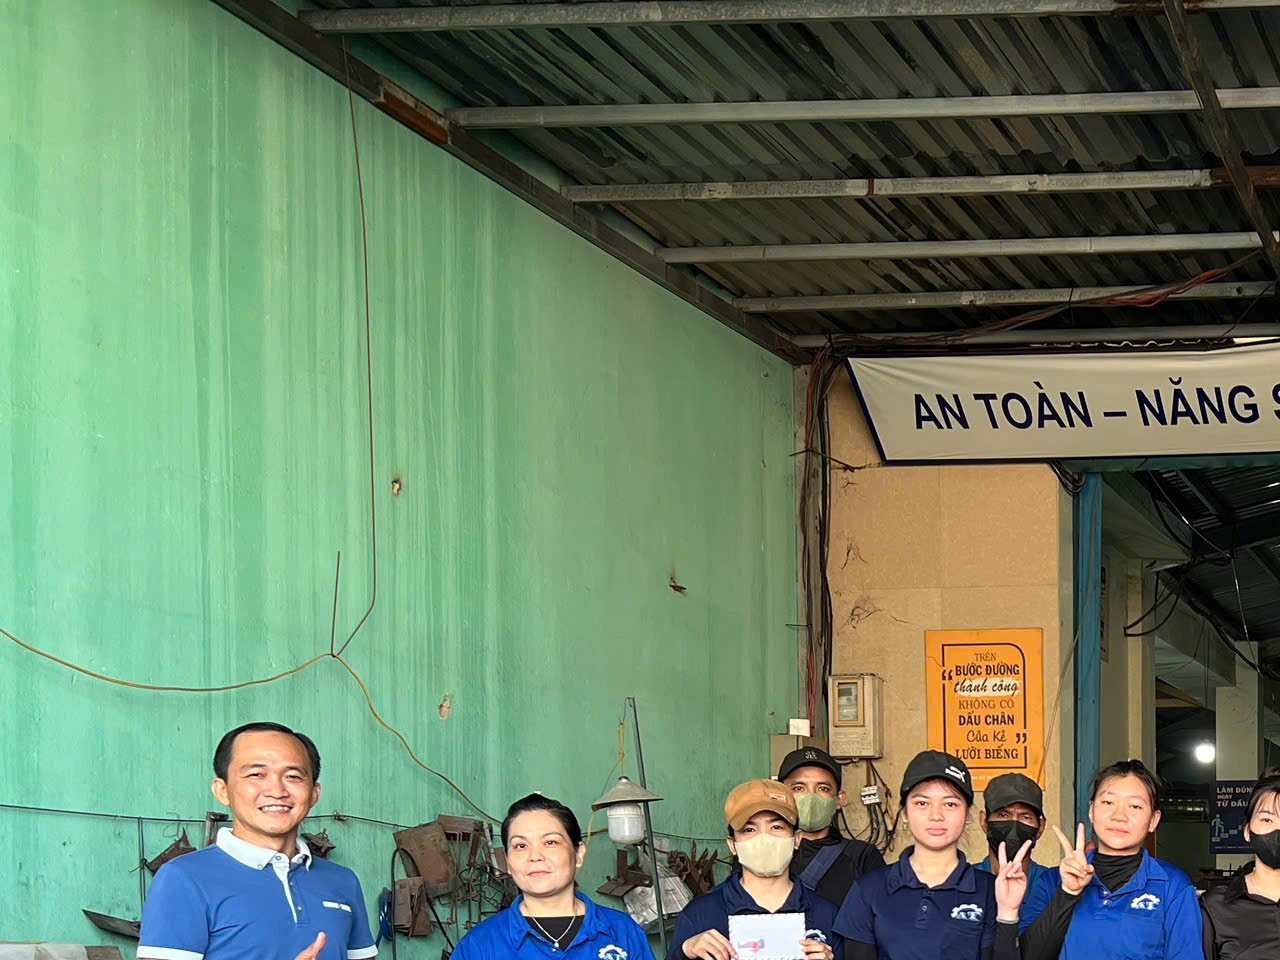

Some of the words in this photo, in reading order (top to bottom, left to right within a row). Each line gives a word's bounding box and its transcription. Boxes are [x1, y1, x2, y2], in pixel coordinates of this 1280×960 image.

[914, 393, 970, 430] AN
[973, 381, 1093, 430] TOÀN
[1135, 376, 1260, 426] NĂNG
[974, 652, 997, 662] TRÊN
[955, 664, 982, 676] BƯỚC
[985, 663, 1020, 676] ĐƯỜNG
[954, 678, 988, 693] thành
[991, 680, 1019, 696] công
[958, 697, 996, 709] KHÔNG
[999, 697, 1015, 709] CÓ
[958, 710, 981, 726] DẤU
[984, 712, 1015, 726] CHÂN
[966, 729, 989, 743] Của
[992, 729, 1007, 743] Kẻ
[955, 748, 981, 760] LƯỜI
[984, 743, 1019, 760] BIẾNG
[1216, 785, 1233, 794] LÀM
[1235, 785, 1253, 794] ĐÚN
